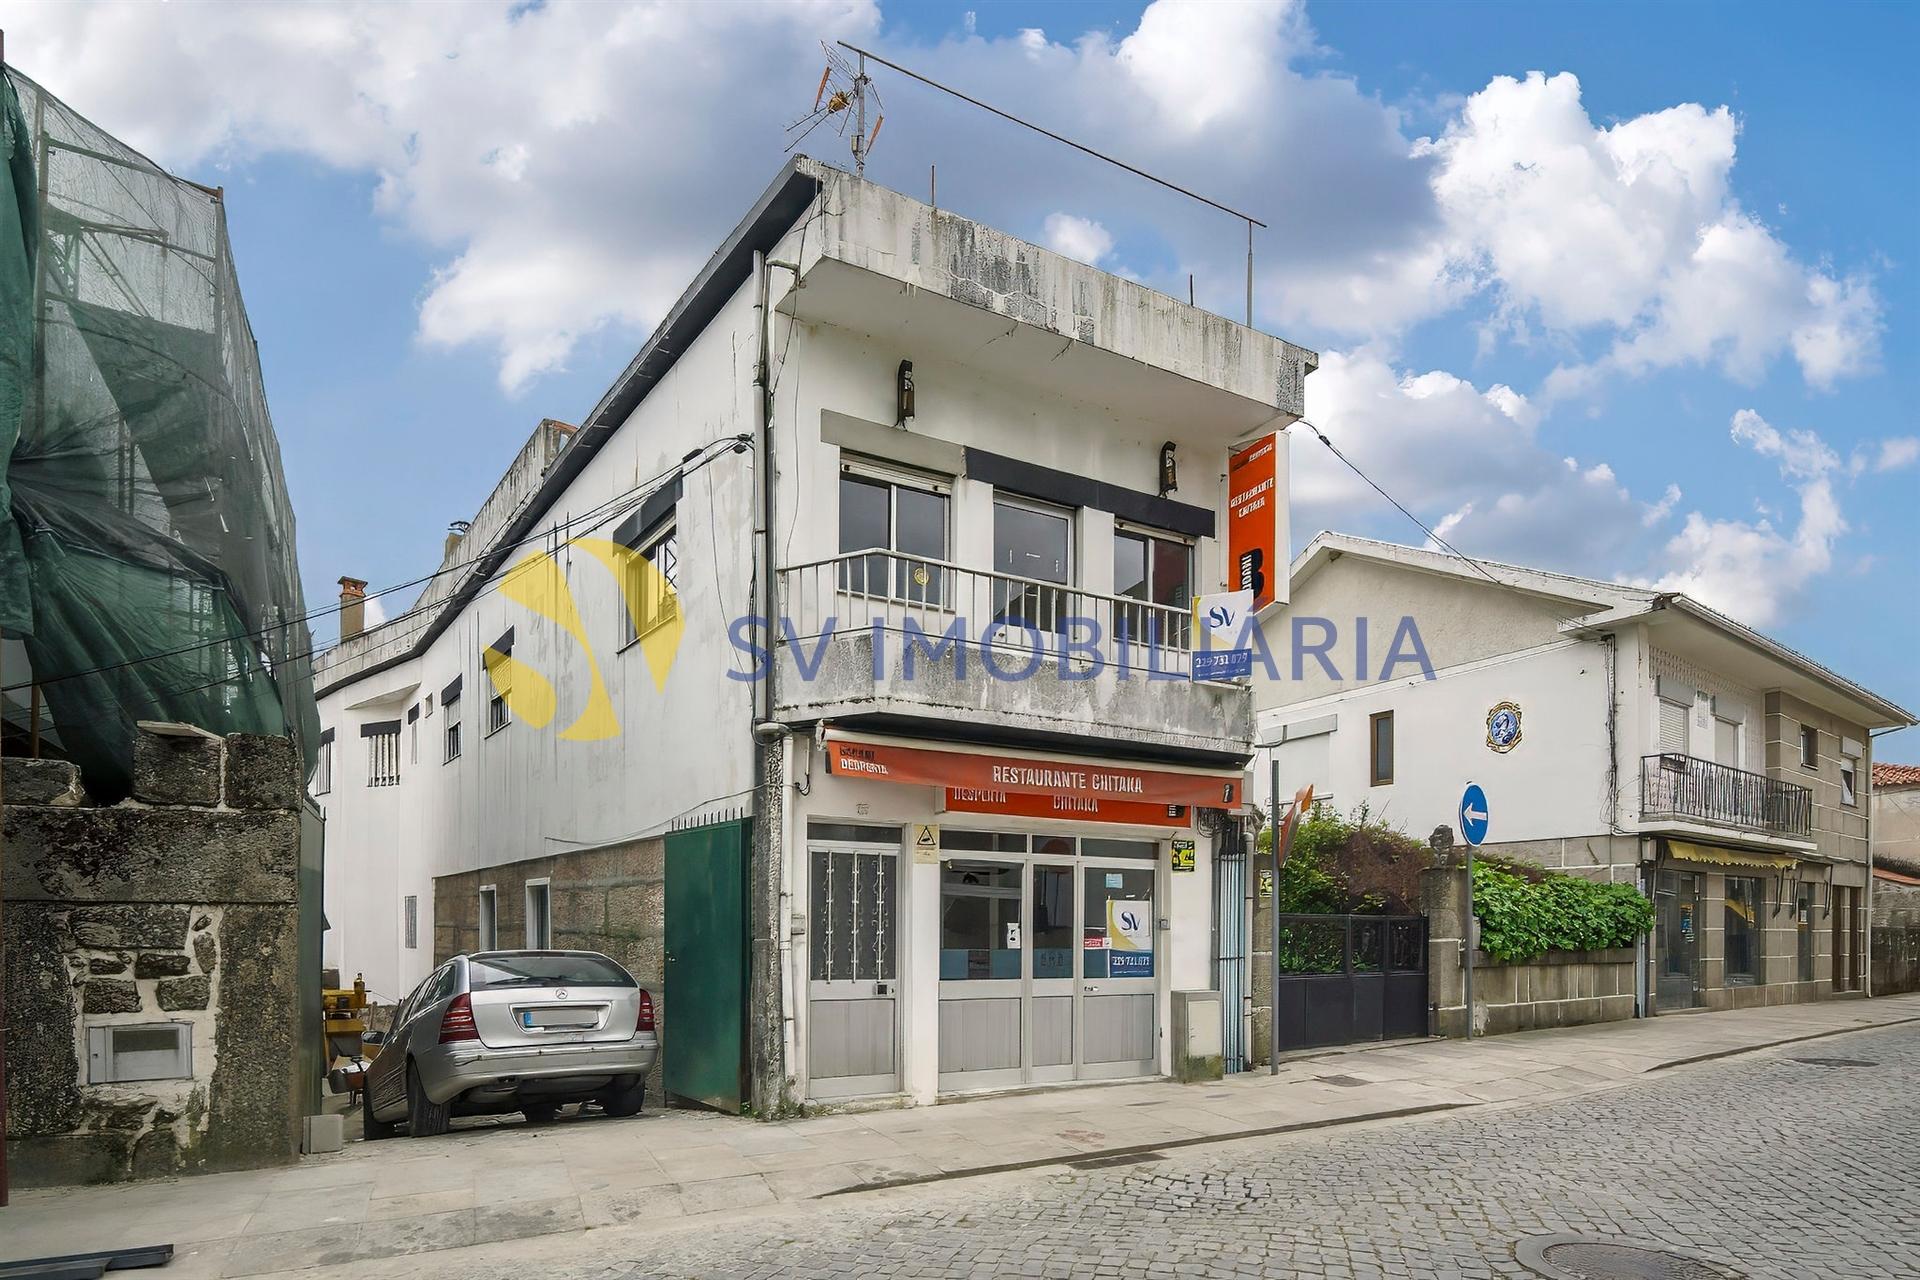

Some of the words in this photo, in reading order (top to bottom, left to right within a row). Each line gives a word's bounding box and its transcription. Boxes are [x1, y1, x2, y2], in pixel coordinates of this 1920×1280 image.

[1209, 606, 1235, 628] SV
[993, 766, 1086, 789] RESTAURANTE
[1121, 911, 1142, 931] SV
